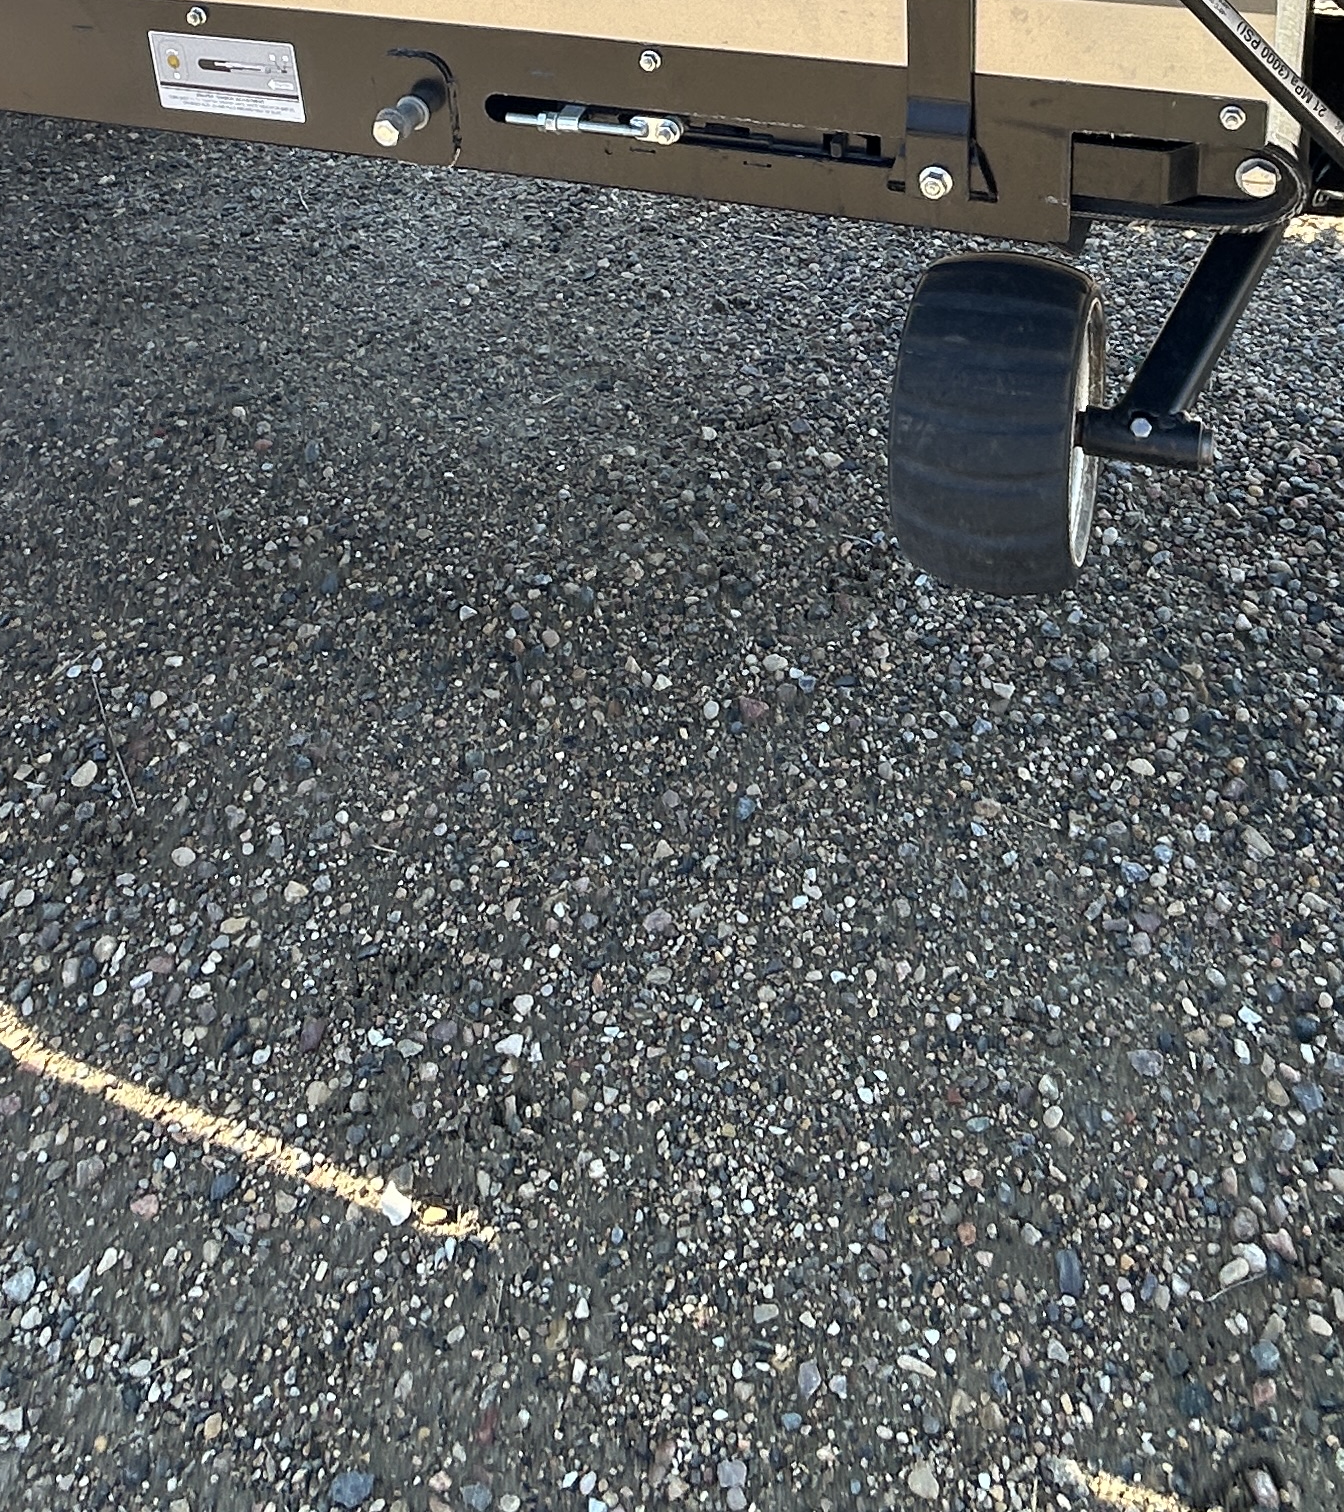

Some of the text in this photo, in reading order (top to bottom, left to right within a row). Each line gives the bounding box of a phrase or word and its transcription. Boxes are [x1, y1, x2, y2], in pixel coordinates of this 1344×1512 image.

[1236, 20, 1328, 117] 21 MPa (3000 PSI)
